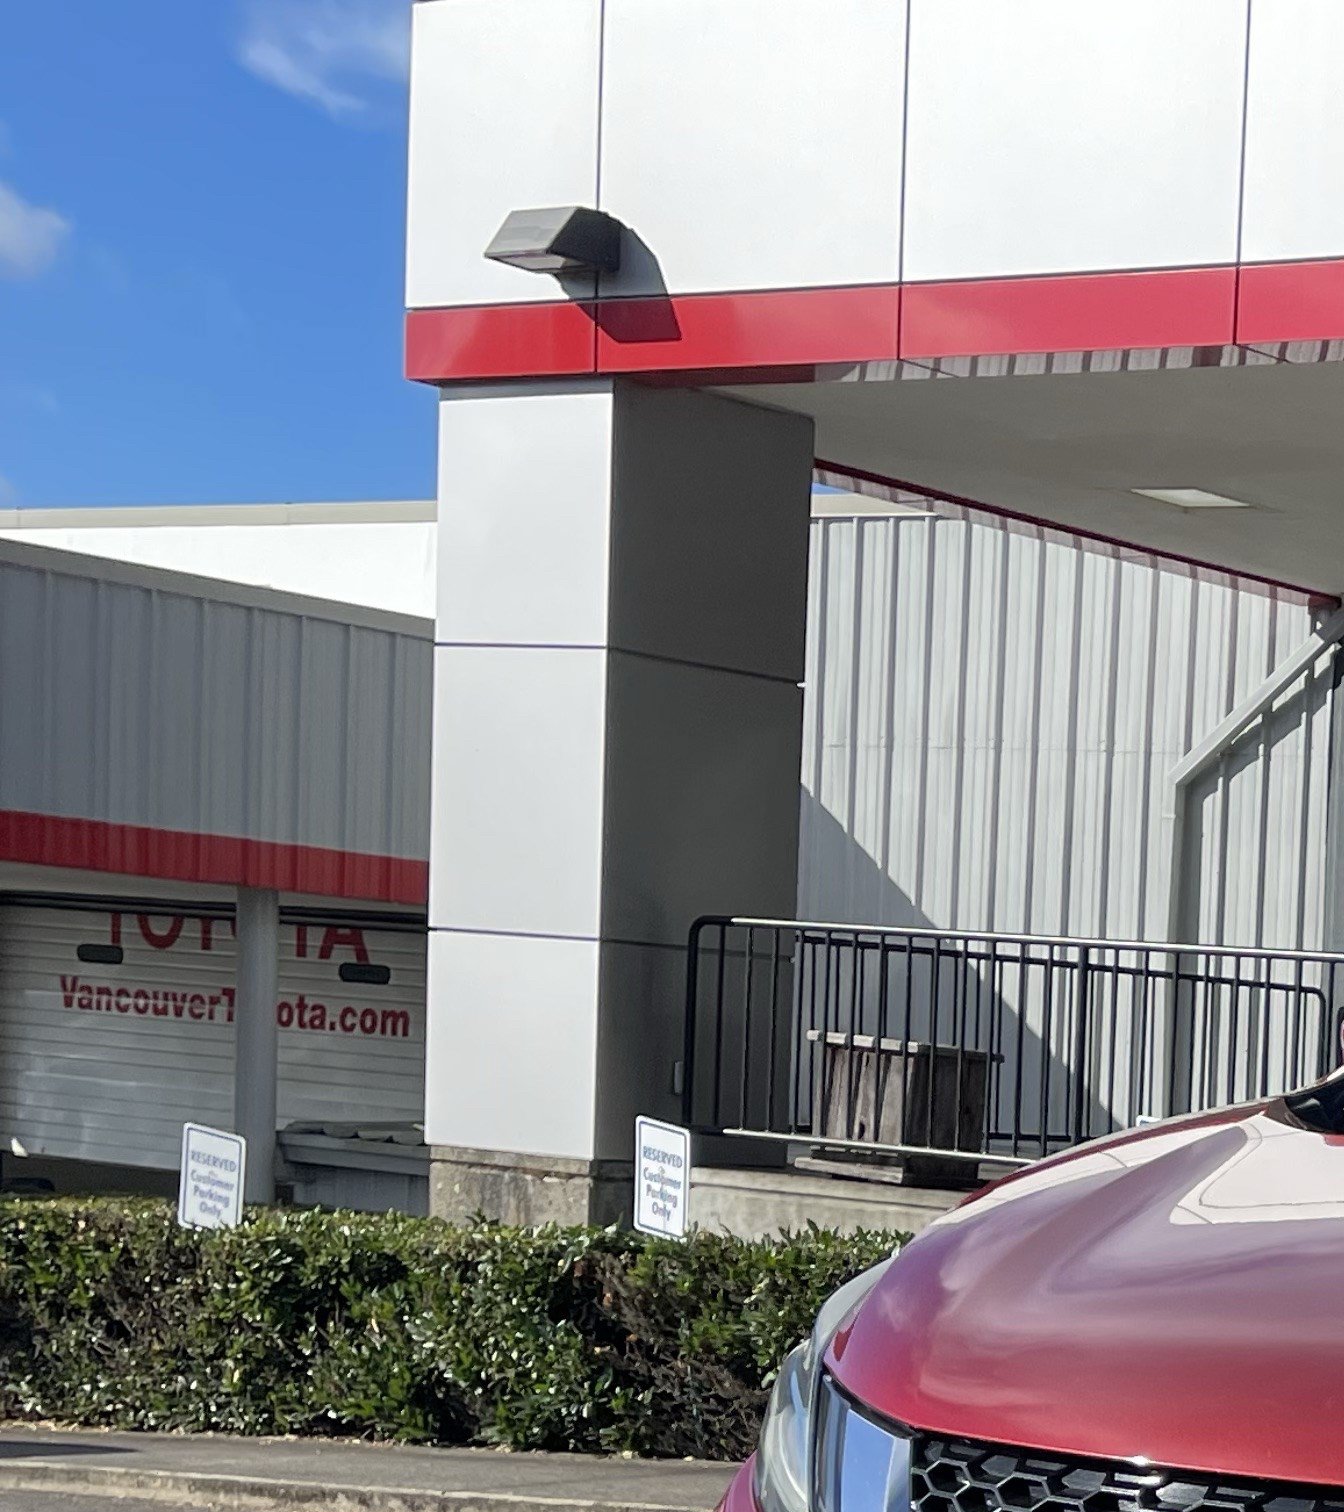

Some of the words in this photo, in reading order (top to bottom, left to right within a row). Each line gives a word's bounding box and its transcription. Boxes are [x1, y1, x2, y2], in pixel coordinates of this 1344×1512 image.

[60, 975, 410, 1037] VancouverTota.com
[191, 1150, 237, 1173] RESERVED
[642, 1145, 683, 1169] RESERVED
[190, 1169, 235, 1192] Customer
[643, 1167, 682, 1190] Customer
[193, 1185, 230, 1208] Parking
[646, 1184, 678, 1208] Parking
[199, 1201, 222, 1219] Only
[652, 1201, 671, 1221] Only
